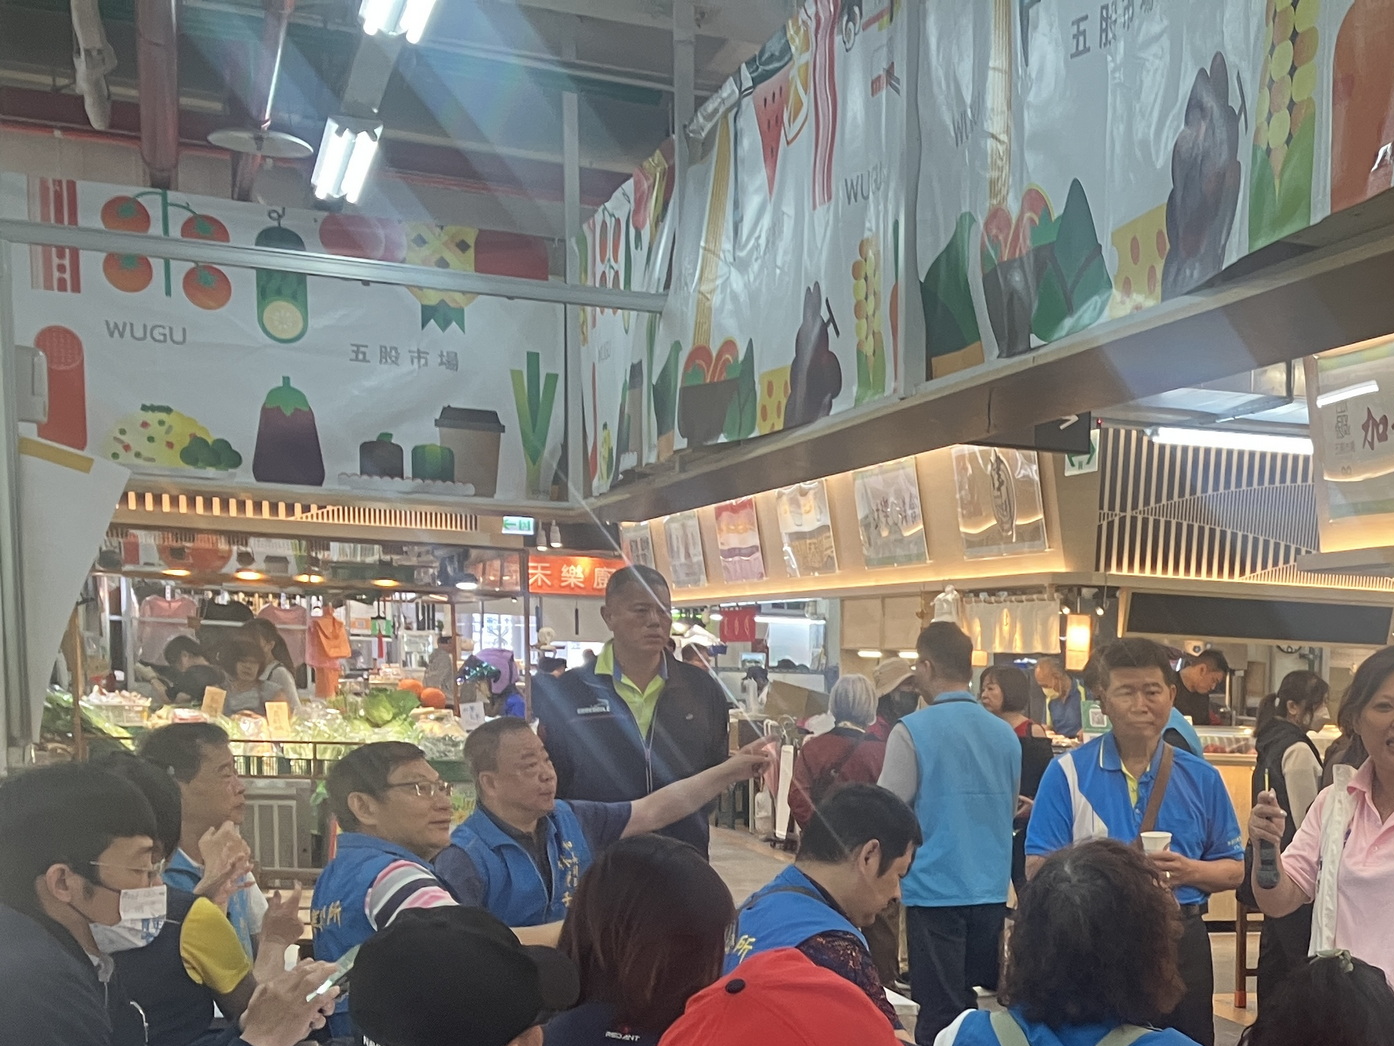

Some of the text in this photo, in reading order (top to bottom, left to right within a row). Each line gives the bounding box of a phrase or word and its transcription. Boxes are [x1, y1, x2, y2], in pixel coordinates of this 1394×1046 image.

[105, 319, 187, 345] WUGU
[350, 343, 459, 371] 五股市場
